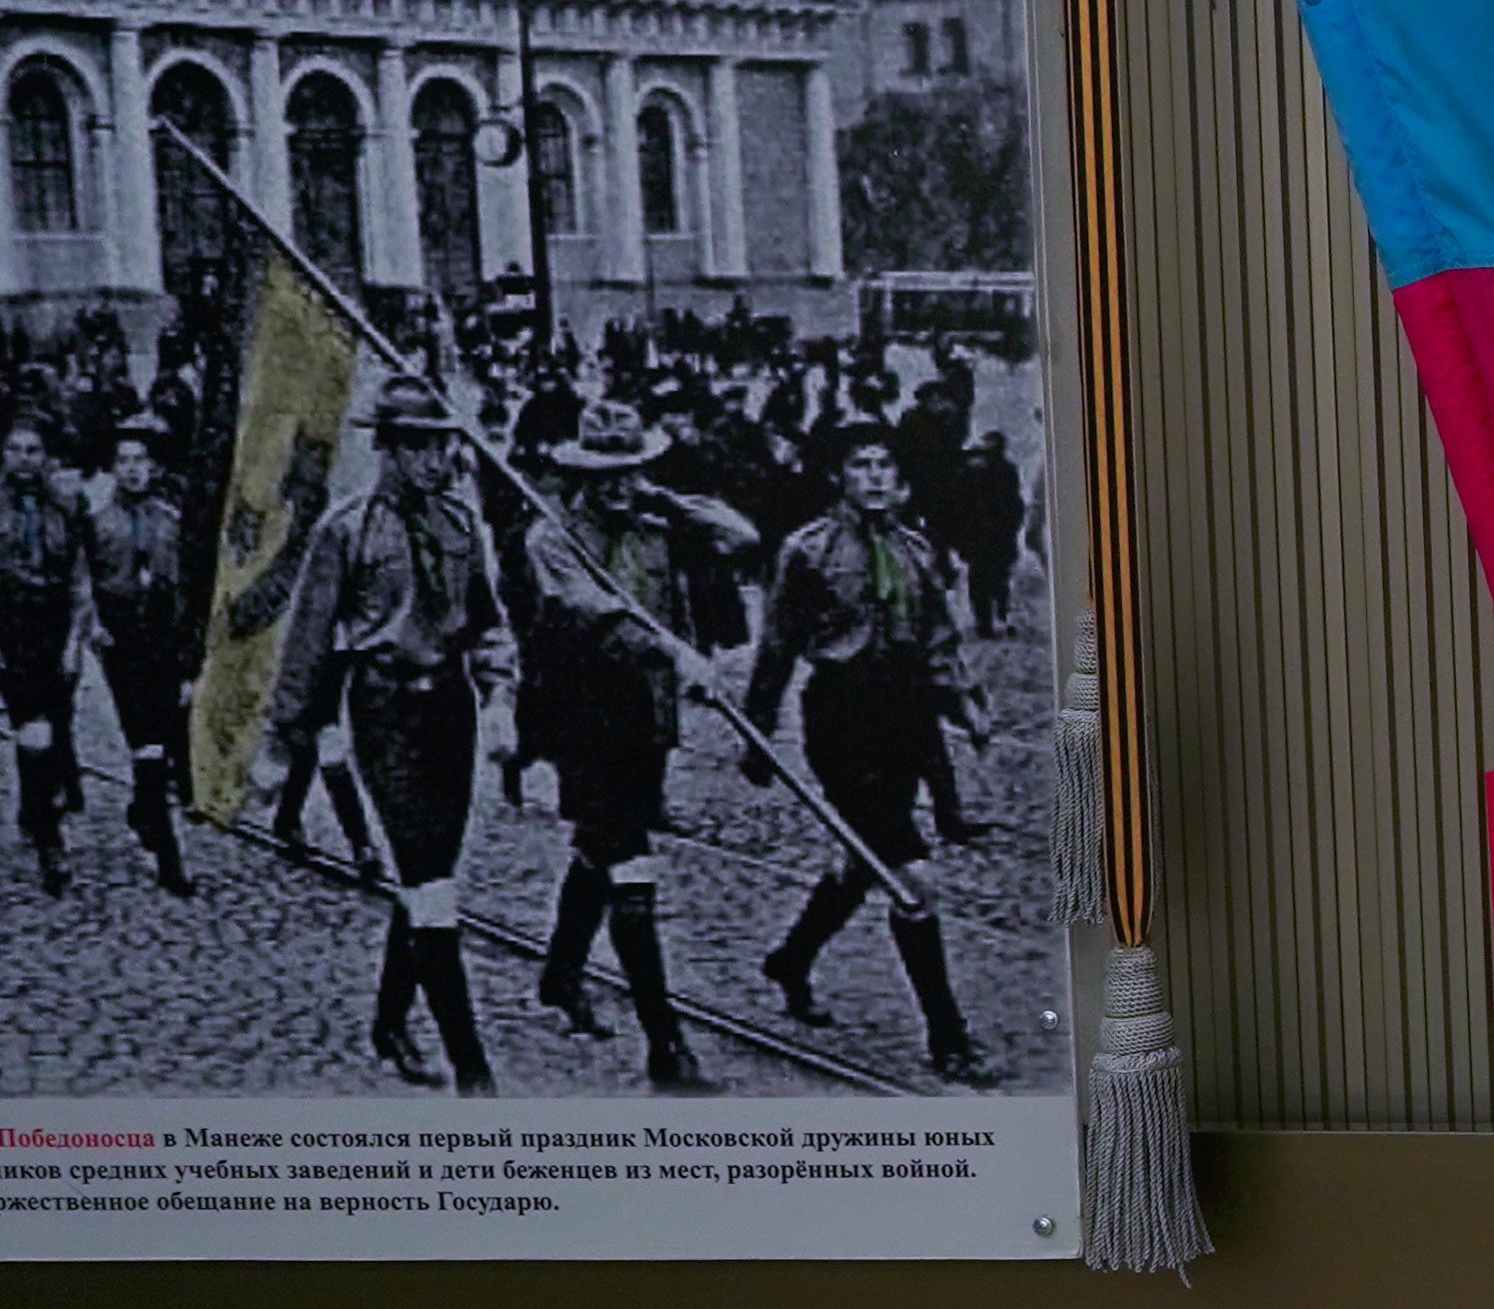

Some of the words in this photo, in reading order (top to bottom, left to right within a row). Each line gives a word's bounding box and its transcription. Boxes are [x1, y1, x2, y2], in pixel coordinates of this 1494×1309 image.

[0, 1129, 155, 1148] Победоносца
[163, 1134, 177, 1147] в
[184, 1128, 283, 1147] Манеже
[290, 1133, 411, 1147] состоялся
[419, 1128, 512, 1153] первый
[521, 1133, 637, 1153] праздник
[643, 1128, 794, 1147] Московской
[802, 1133, 916, 1152] дружины
[924, 1132, 995, 1146] юных
[0, 1165, 62, 1179] иков
[69, 1165, 168, 1184] средних
[174, 1160, 281, 1184] учебных
[287, 1160, 410, 1181] заведений
[419, 1165, 433, 1179] и
[441, 1165, 495, 1180] дети
[503, 1160, 618, 1181] беженцев
[626, 1165, 652, 1179] из
[659, 1165, 720, 1183] мест,
[727, 1160, 874, 1184] разорённых
[882, 1159, 976, 1178] войной.
[156, 1191, 276, 1212] обещание
[283, 1197, 312, 1210] на
[319, 1197, 430, 1216] верность
[437, 1192, 559, 1216] Государю.
